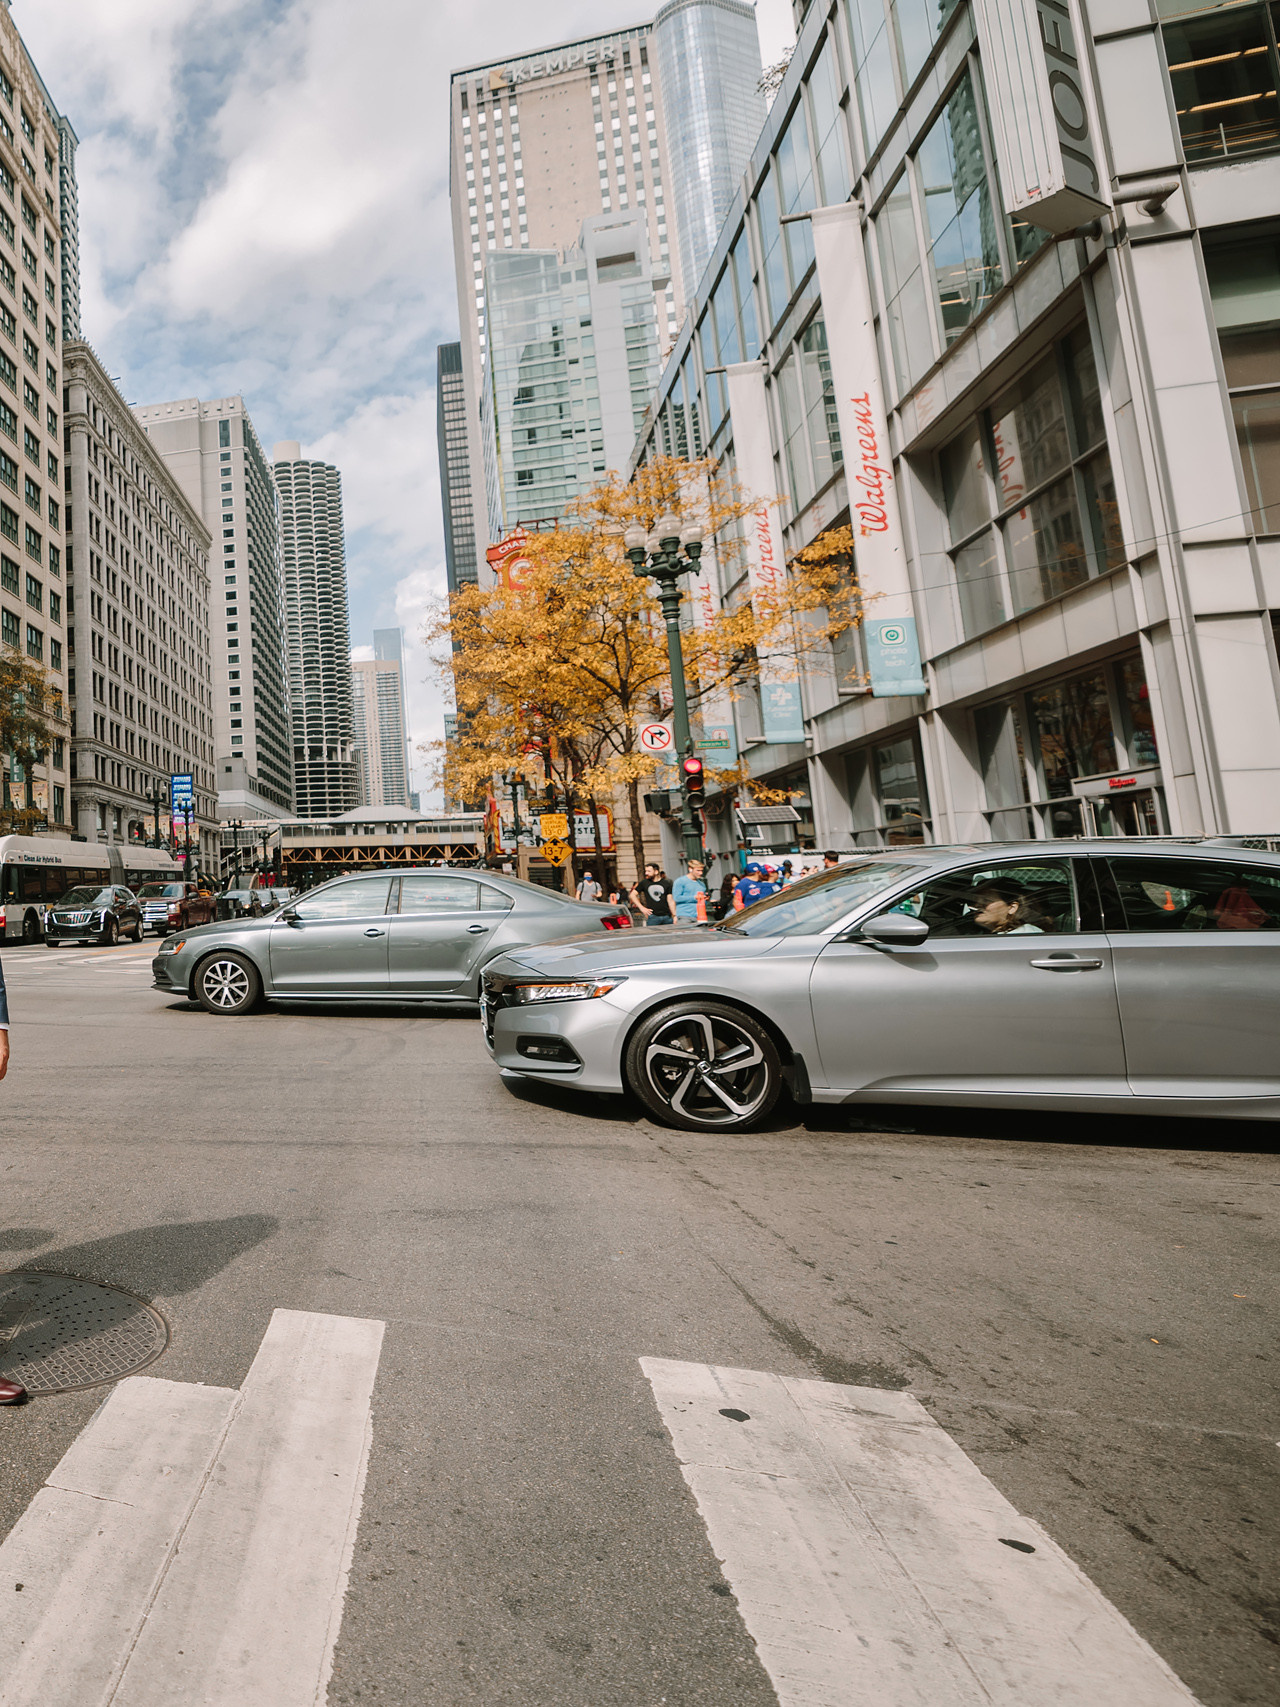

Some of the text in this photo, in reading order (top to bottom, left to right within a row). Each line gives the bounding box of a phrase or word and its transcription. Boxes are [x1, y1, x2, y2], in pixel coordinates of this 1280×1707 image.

[511, 42, 616, 82] KEMPER
[850, 391, 893, 537] Walgreens
[498, 539, 526, 554] CHAS
